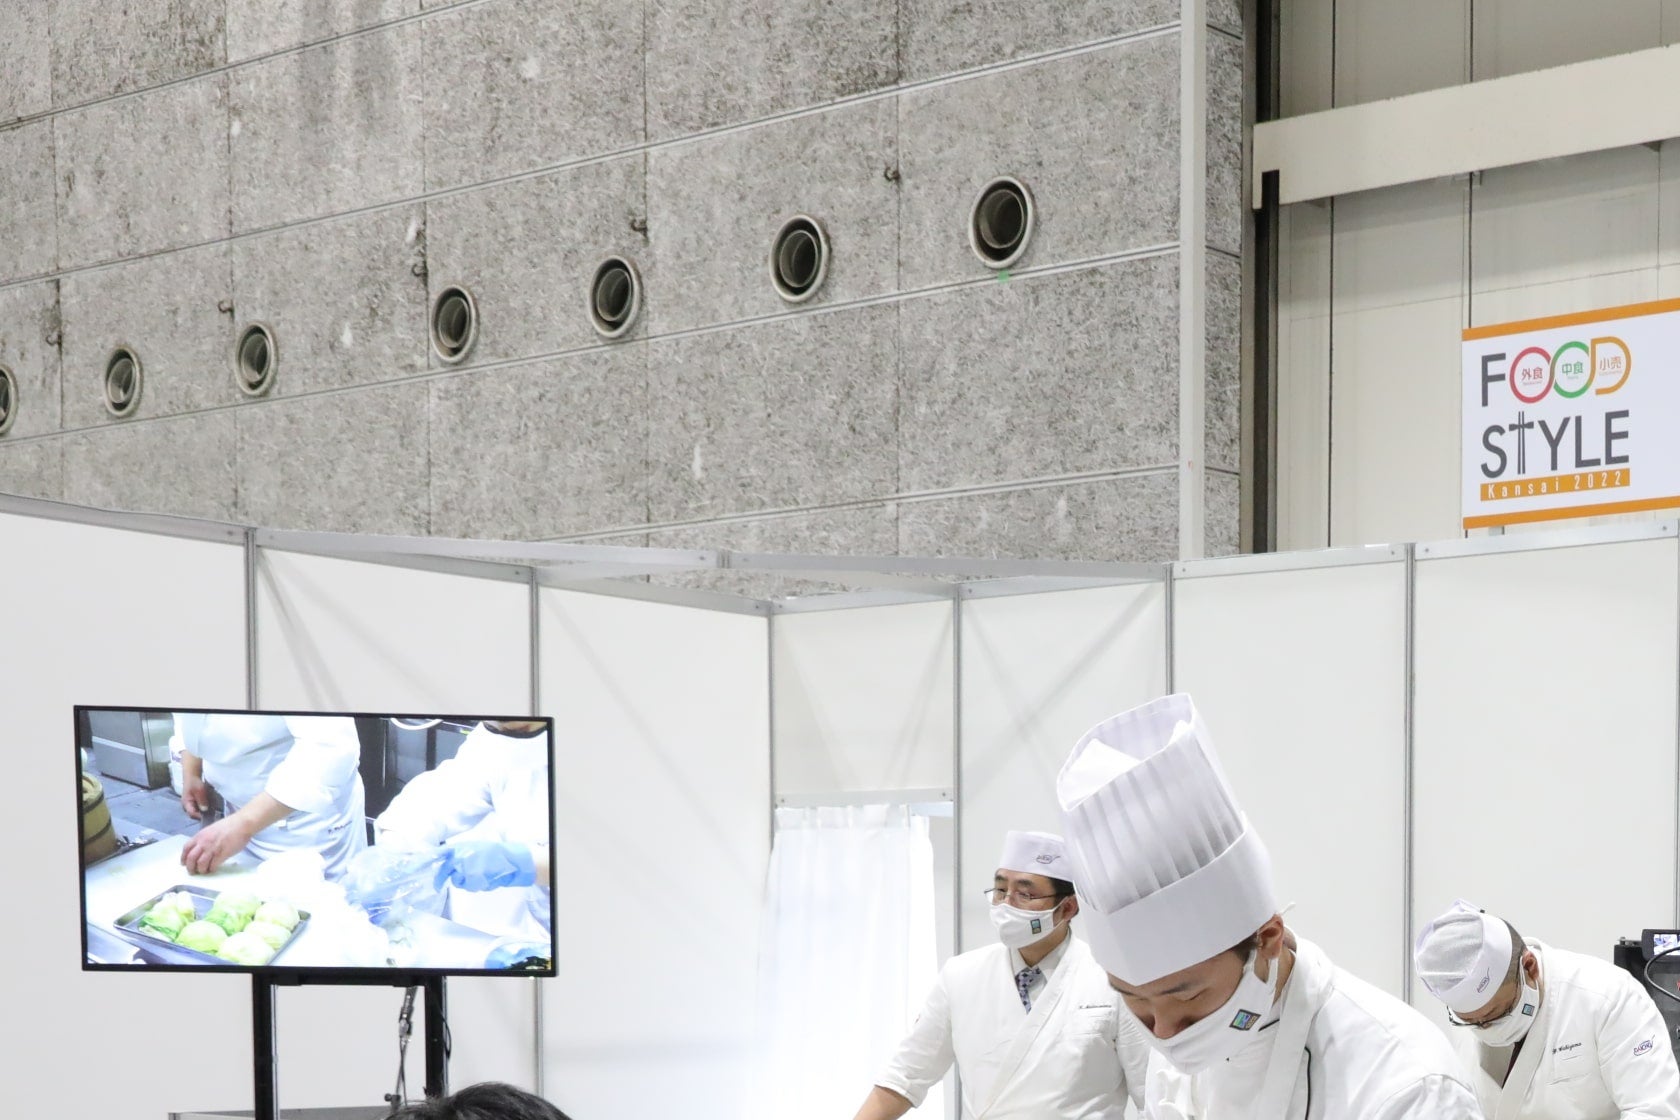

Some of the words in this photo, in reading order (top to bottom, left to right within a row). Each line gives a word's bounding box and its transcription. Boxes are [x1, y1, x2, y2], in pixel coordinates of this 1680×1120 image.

[1481, 336, 1632, 407] FOOD
[1521, 366, 1543, 381] 外食
[1561, 361, 1584, 376] 中食
[1480, 410, 1630, 479] STYLE
[1488, 477, 1560, 499] Kansai
[1574, 470, 1621, 490] 2022
